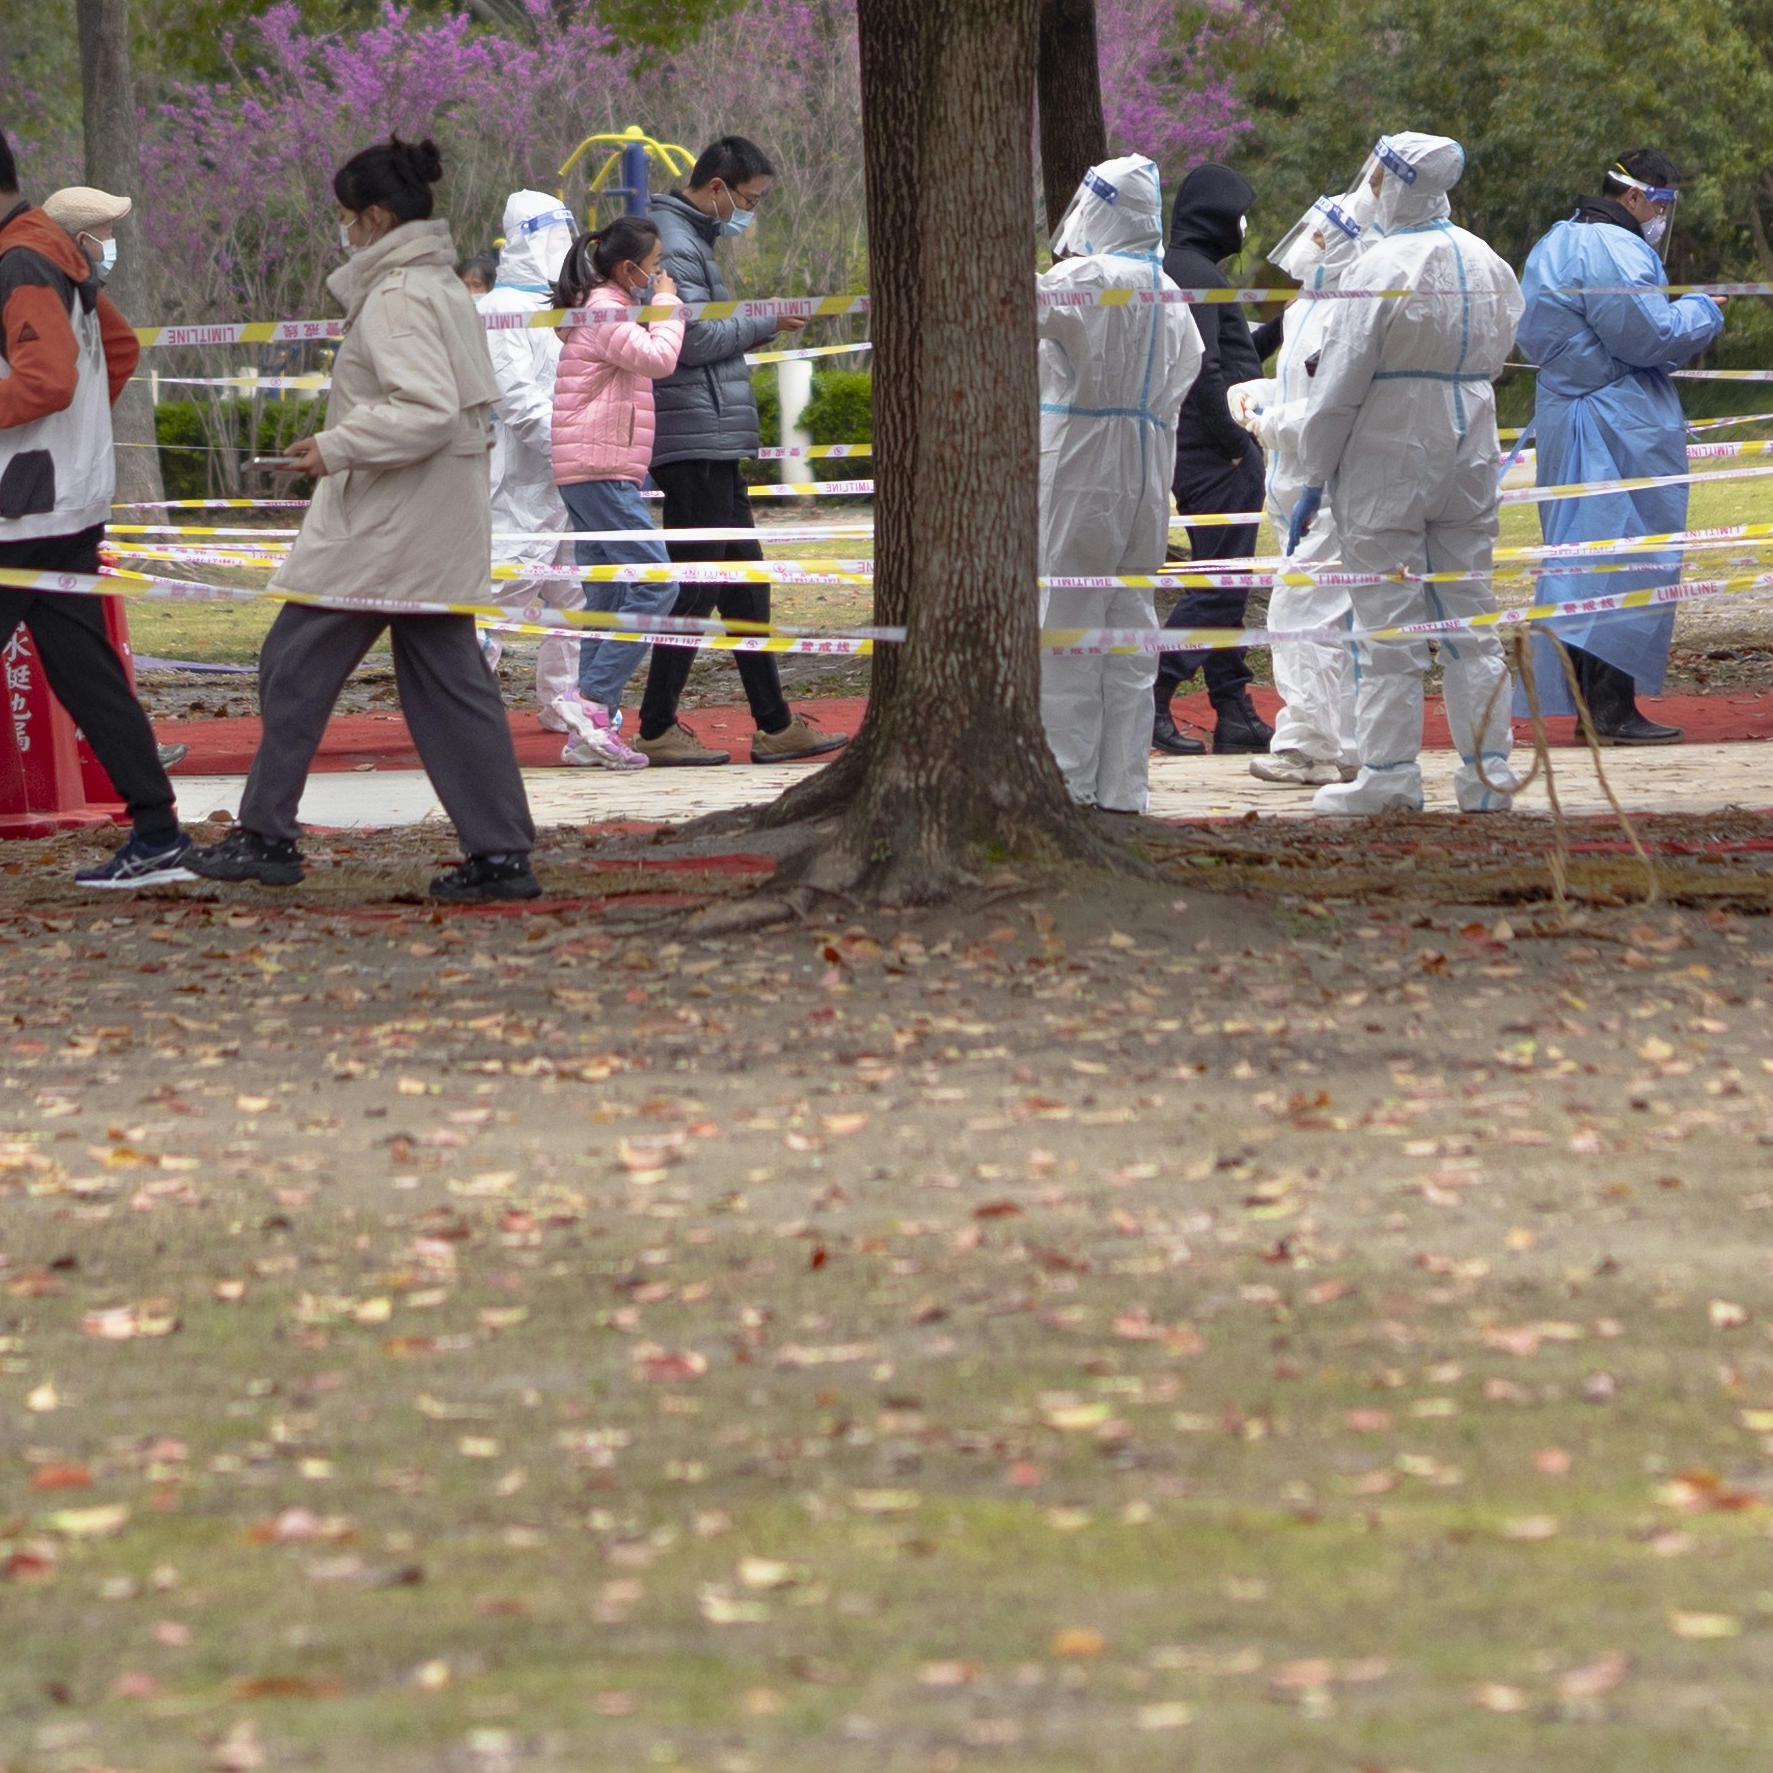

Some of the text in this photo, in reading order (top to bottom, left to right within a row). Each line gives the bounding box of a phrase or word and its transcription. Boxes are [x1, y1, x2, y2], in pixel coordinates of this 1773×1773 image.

[1037, 293, 1094, 306] LIMITLIN
[745, 301, 811, 317] LIMITLINE
[481, 313, 523, 330] LIMIT
[168, 328, 235, 344] LIMITLINE
[1657, 583, 1718, 602] LIMITLINE
[801, 640, 850, 654] 警戒线
